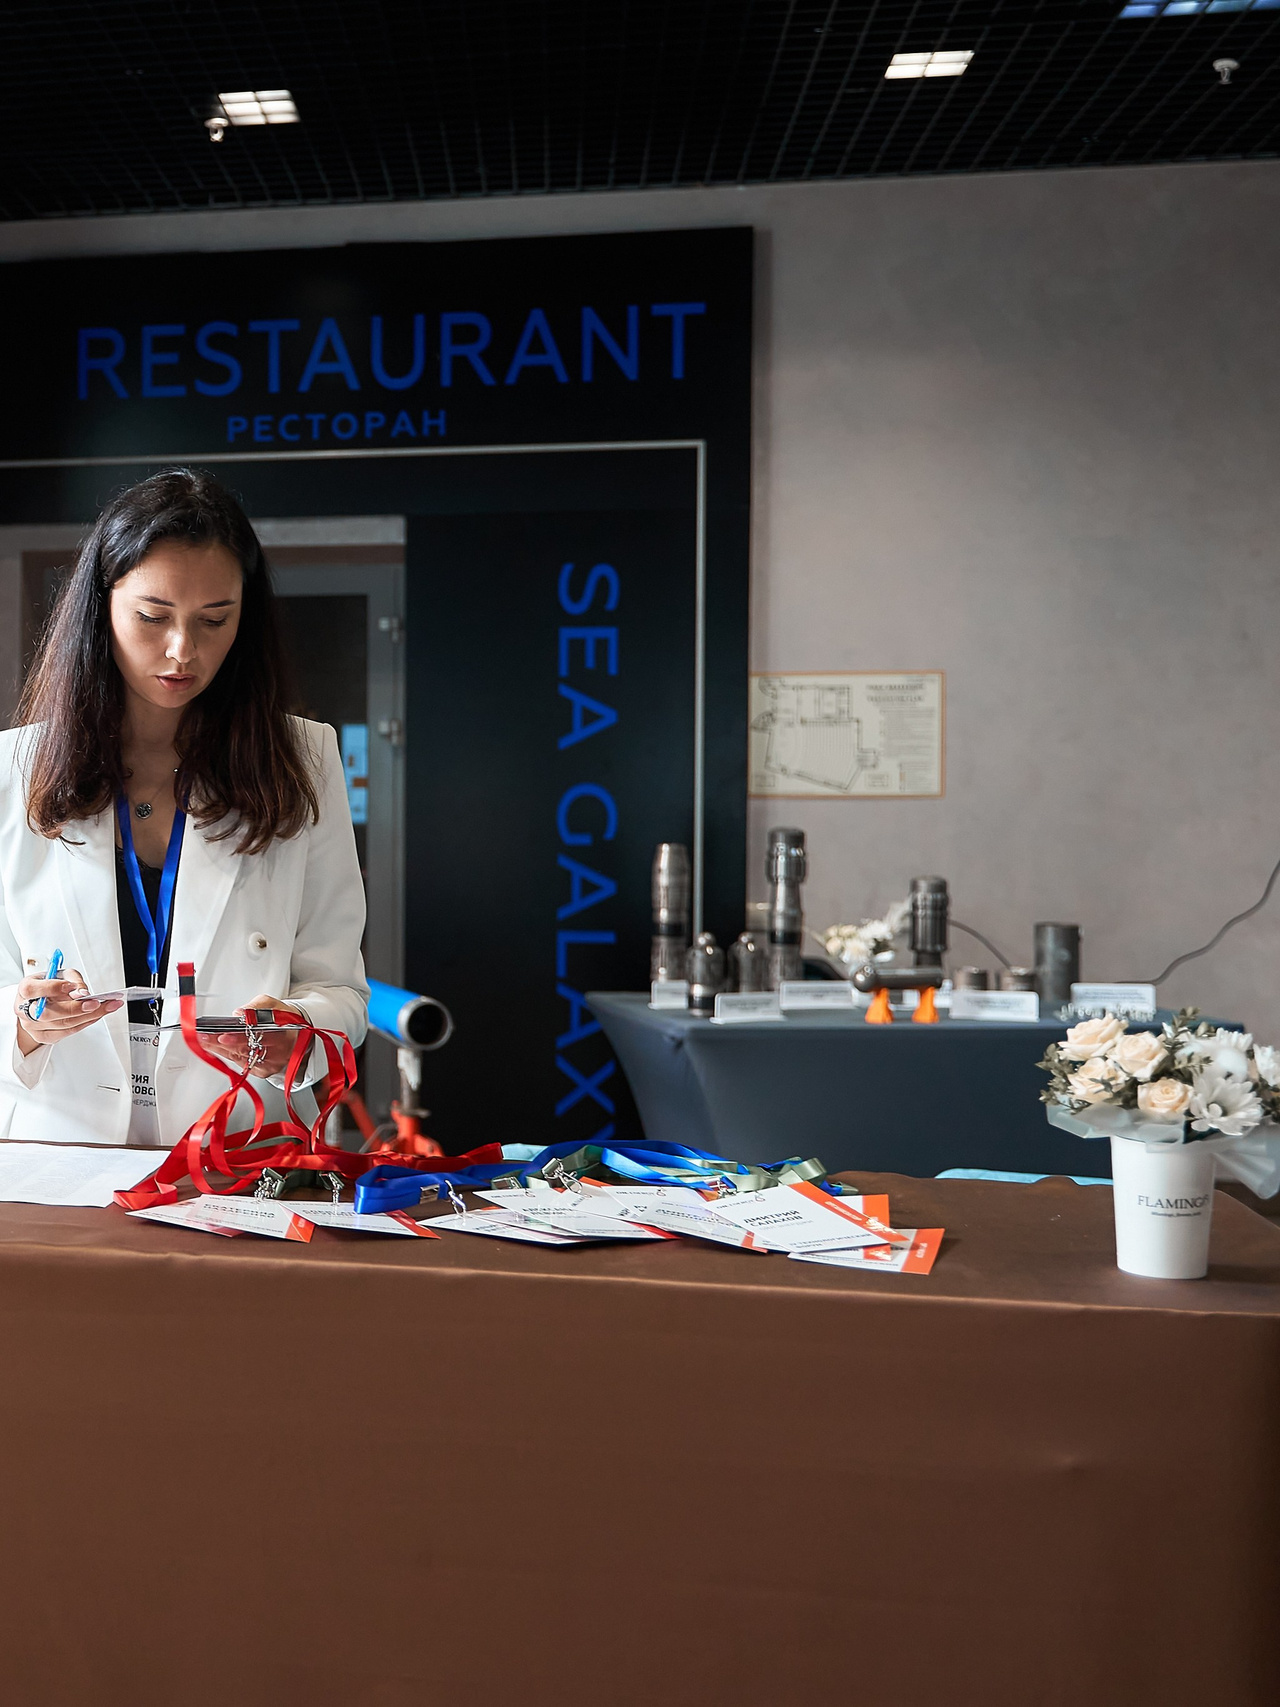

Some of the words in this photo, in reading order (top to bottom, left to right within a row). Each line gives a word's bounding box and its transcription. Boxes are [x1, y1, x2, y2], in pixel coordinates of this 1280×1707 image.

[78, 301, 707, 399] RESTAURANT
[226, 409, 447, 443] РЕСТОРАН
[556, 562, 620, 751] SEA
[131, 1073, 150, 1084] РИЯ
[131, 1085, 156, 1096] ОВС
